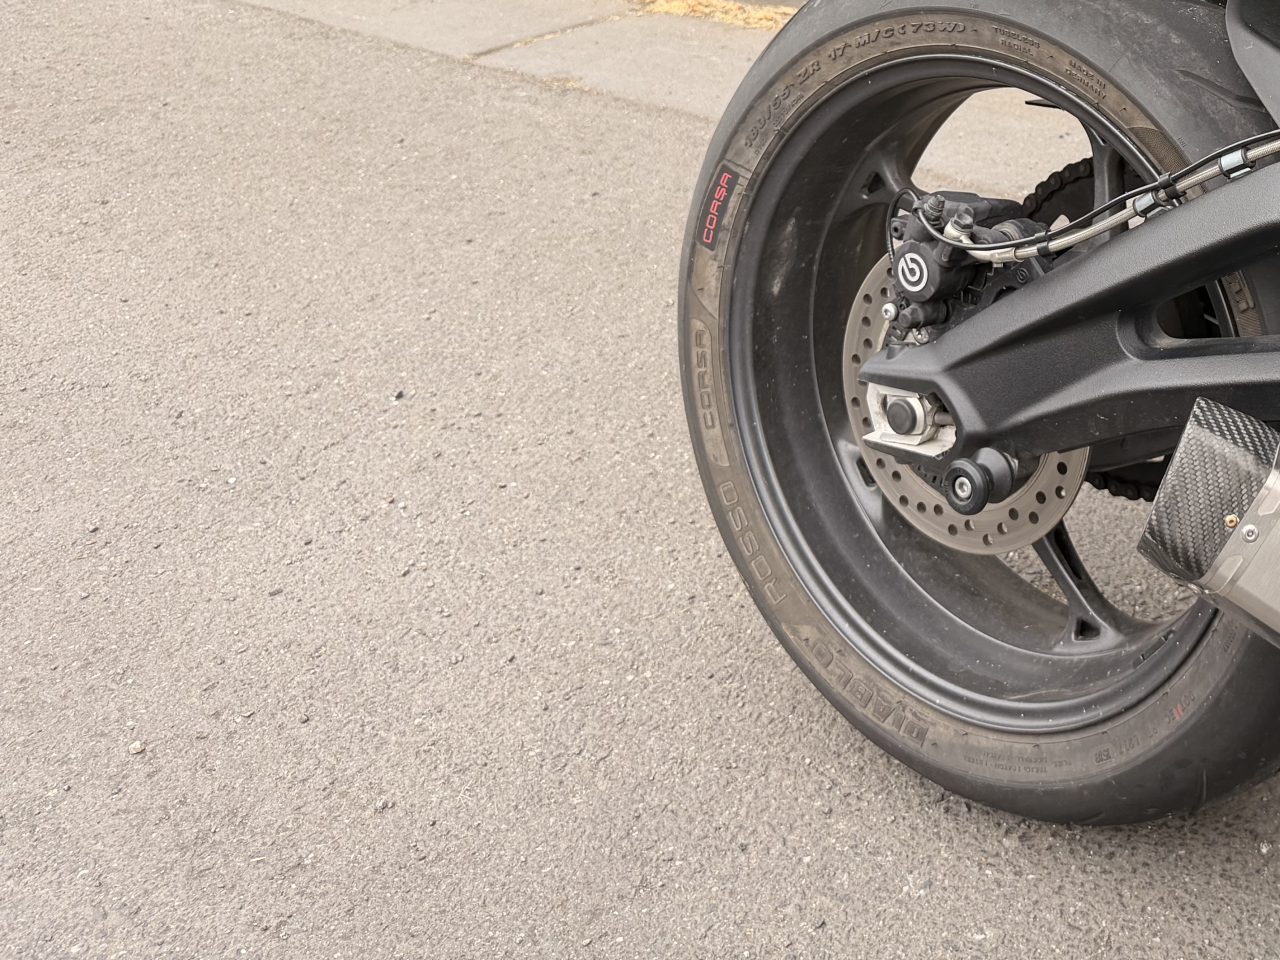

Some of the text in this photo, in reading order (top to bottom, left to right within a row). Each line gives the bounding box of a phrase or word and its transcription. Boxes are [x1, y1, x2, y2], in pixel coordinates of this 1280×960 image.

[703, 172, 732, 244] CORSA
[695, 329, 716, 430] CORSA
[719, 480, 787, 606] ROSSO
[812, 643, 930, 747] DIABLO
